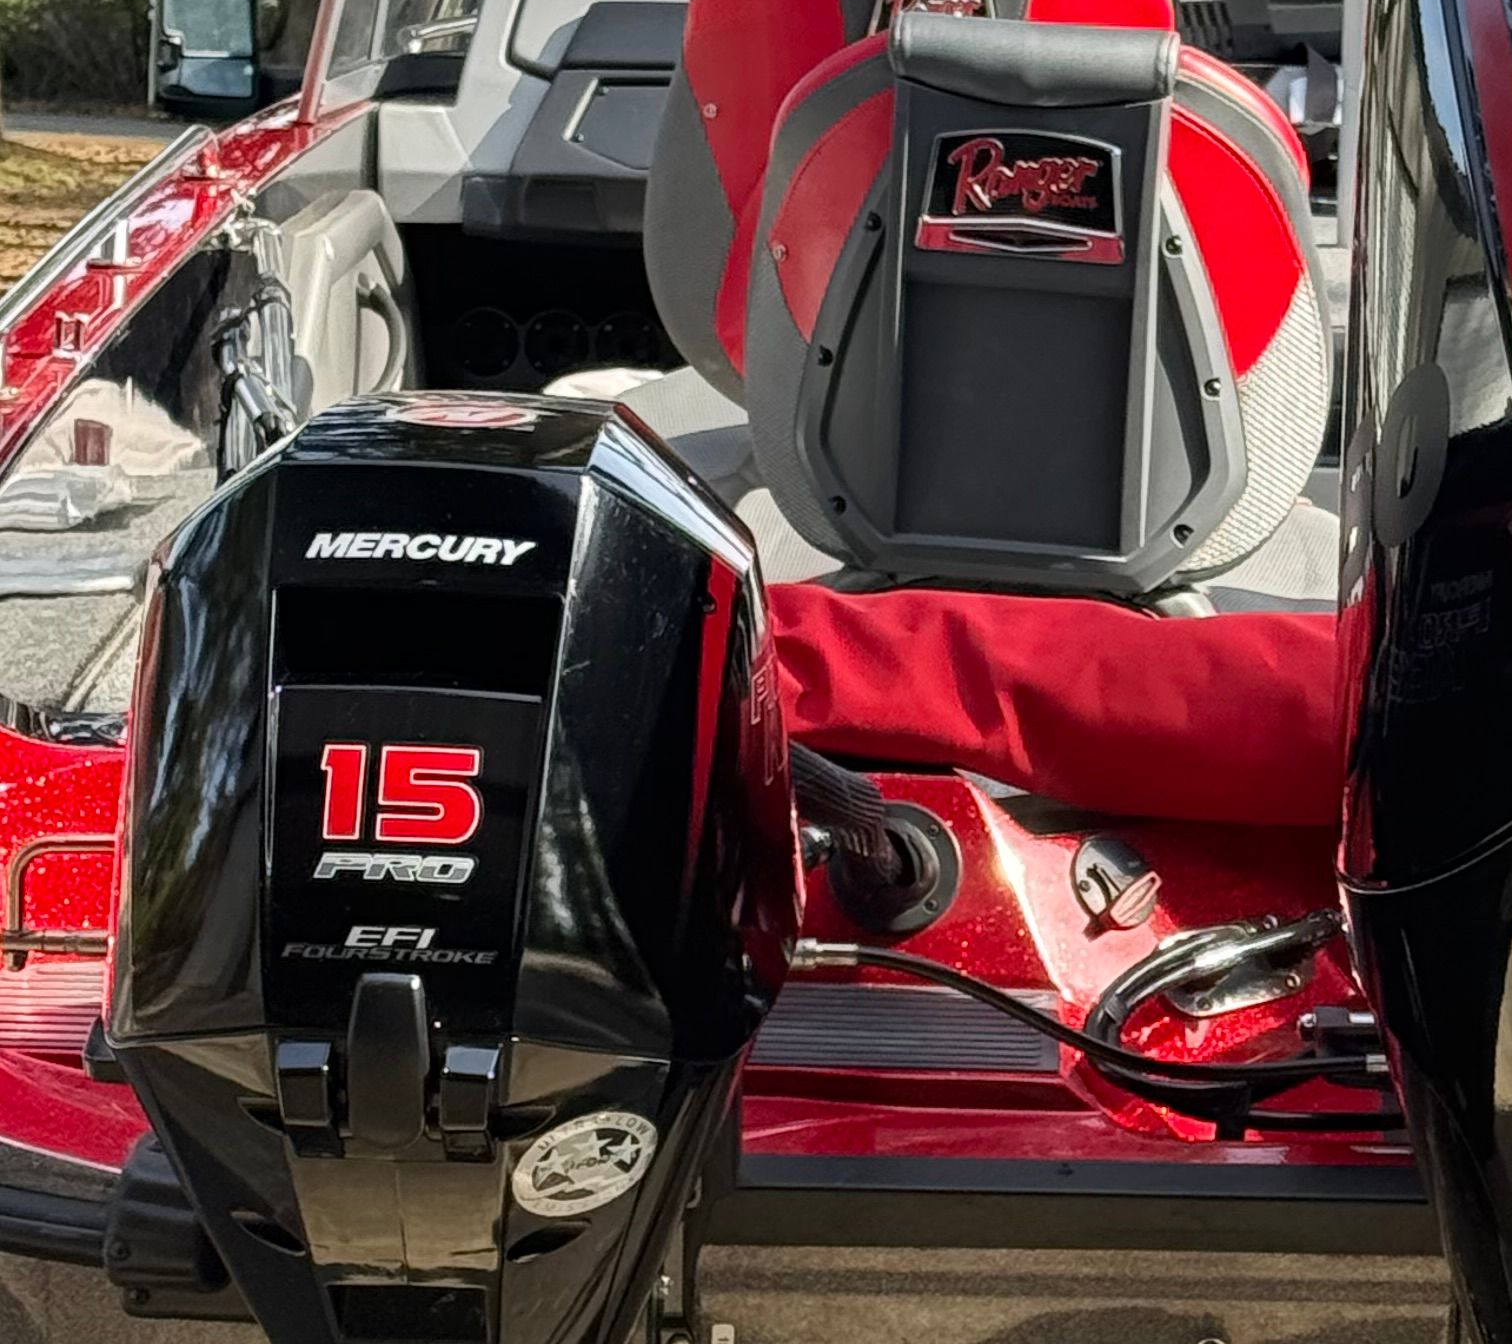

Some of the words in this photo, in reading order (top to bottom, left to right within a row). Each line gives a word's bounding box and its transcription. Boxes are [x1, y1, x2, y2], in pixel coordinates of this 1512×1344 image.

[947, 138, 1101, 215] Ranger
[305, 531, 536, 566] MERCURY
[321, 744, 481, 844] 15
[312, 852, 476, 884] PRO
[280, 942, 499, 966] FOURSTROKE
[343, 925, 438, 950] EFI
